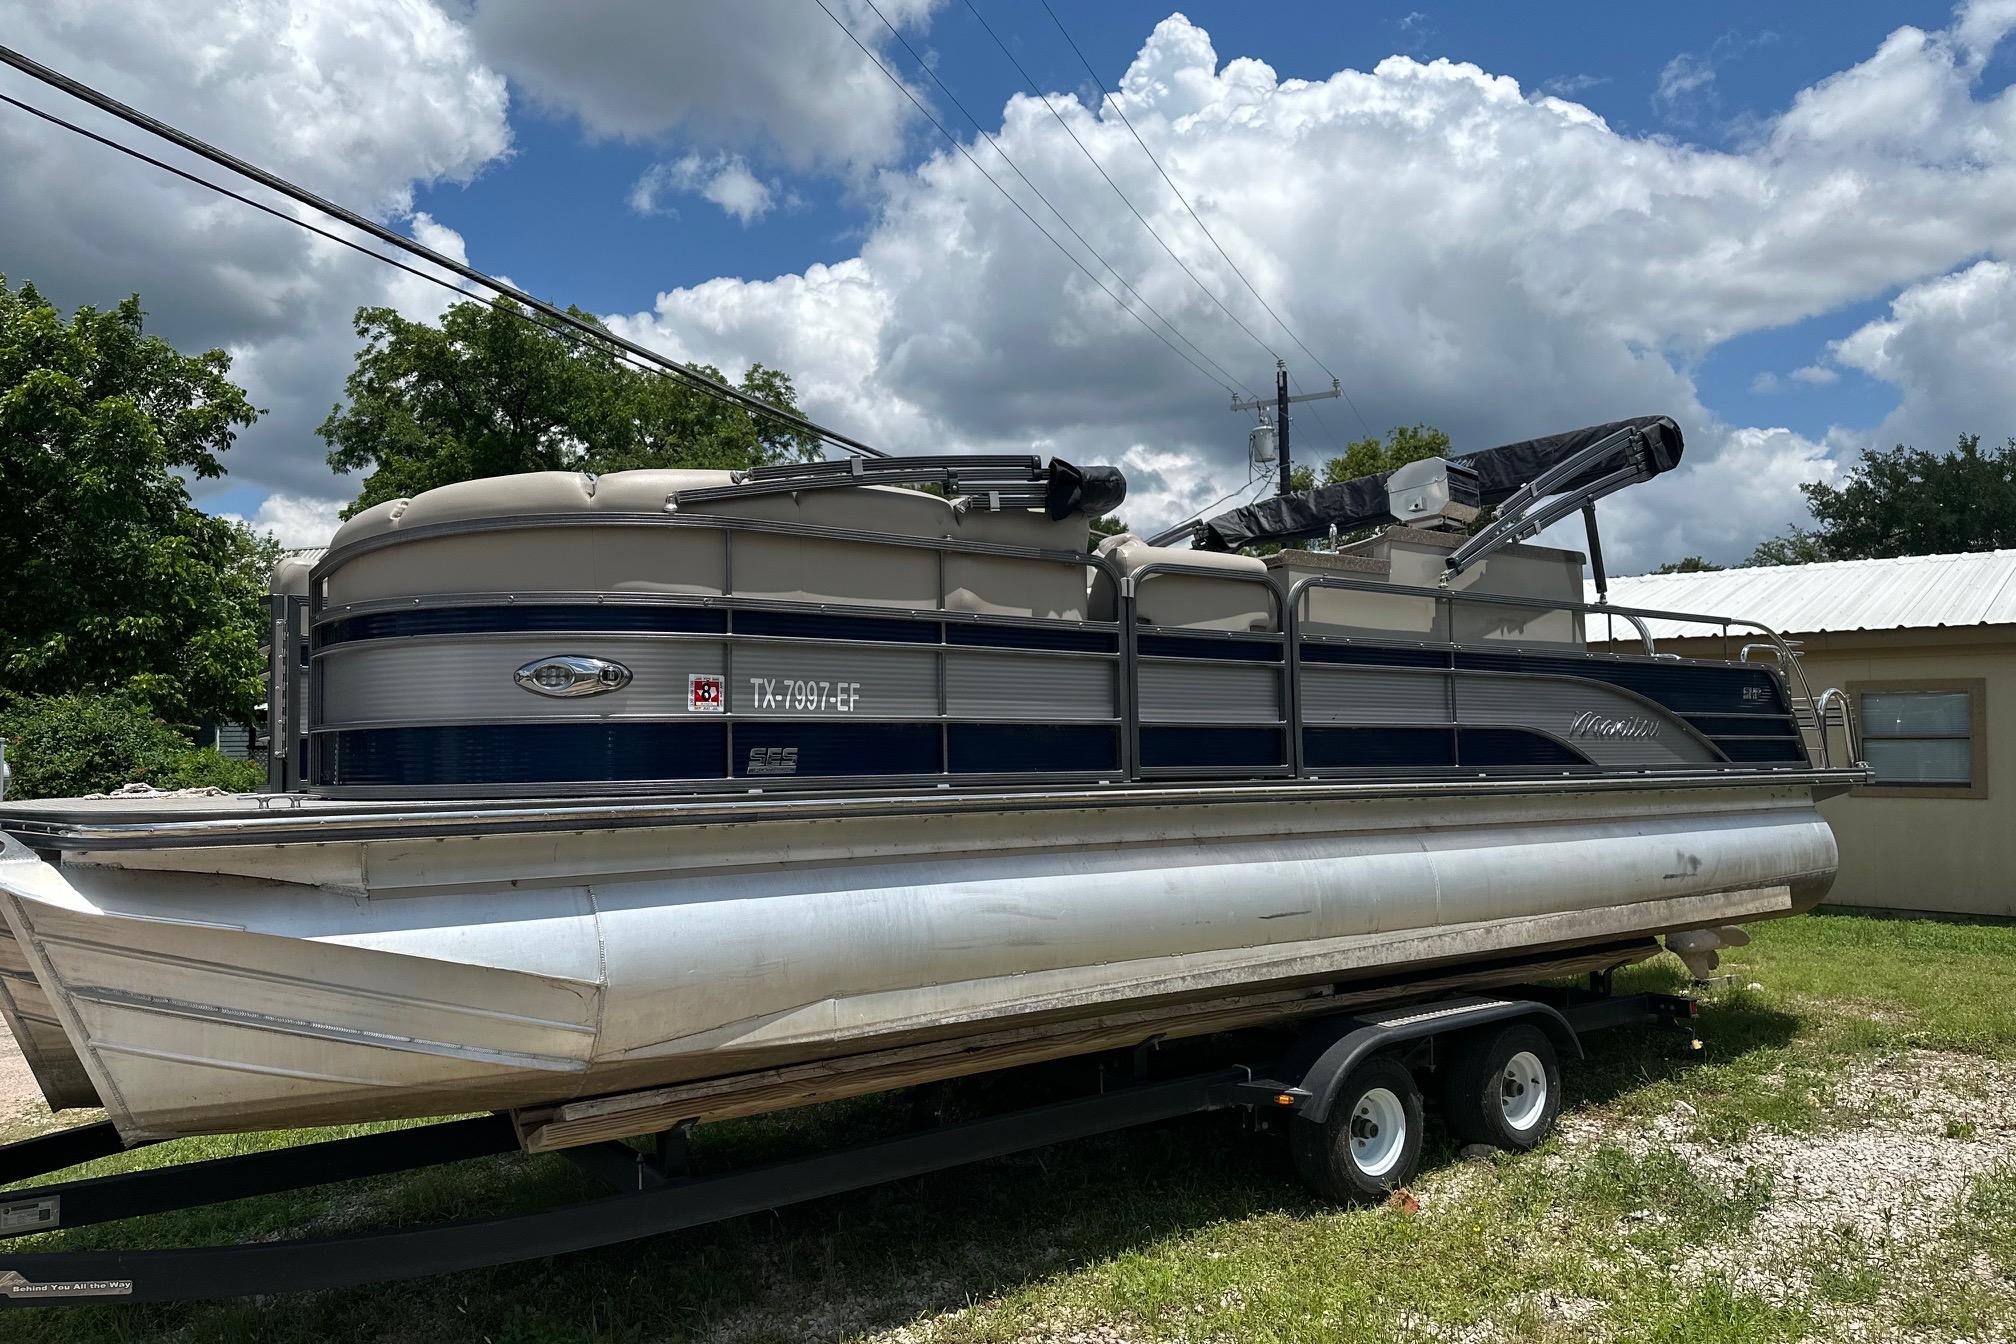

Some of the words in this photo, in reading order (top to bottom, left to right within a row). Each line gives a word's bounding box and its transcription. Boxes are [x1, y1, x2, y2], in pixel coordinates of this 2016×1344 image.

[702, 681, 711, 702] 8
[750, 678, 861, 712] TX-7997-EF
[749, 748, 798, 766] SES
[109, 1281, 131, 1289] Way
